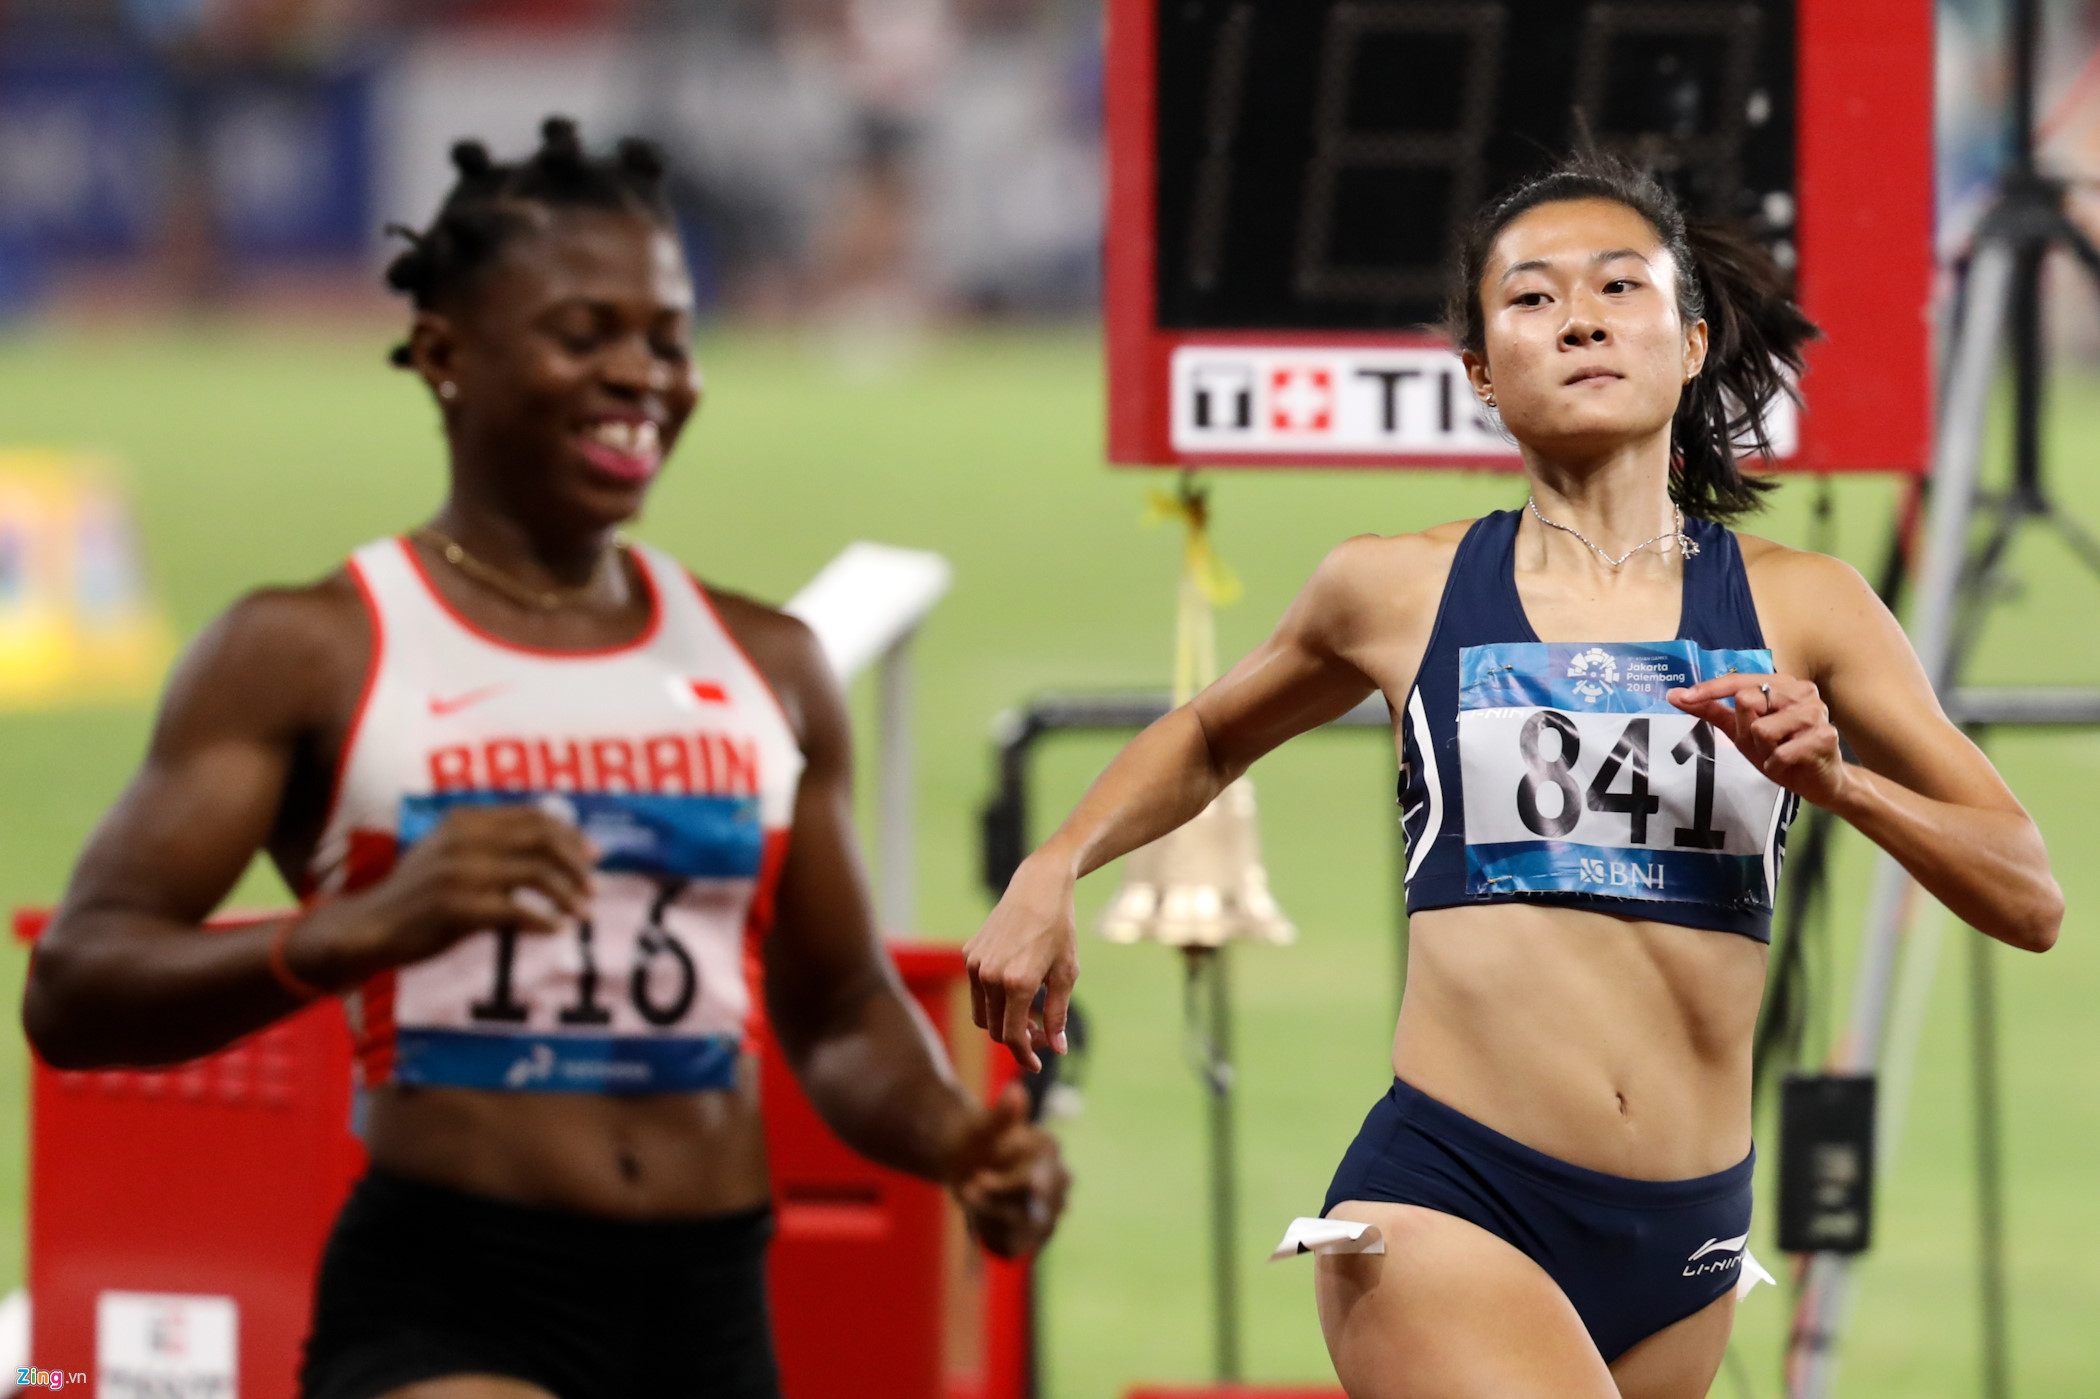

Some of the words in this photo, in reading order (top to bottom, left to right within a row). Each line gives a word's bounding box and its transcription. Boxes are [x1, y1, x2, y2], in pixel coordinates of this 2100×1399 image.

[1355, 369, 1491, 433] TI
[1626, 672, 1685, 683] Palembang
[1627, 663, 1669, 671] Jakarta
[1626, 683, 1651, 692] 2018
[430, 735, 757, 795] BAHRAIN
[1516, 710, 1726, 850] 841
[1609, 861, 1665, 889] BNI
[1682, 1255, 1743, 1277] LI-NIN
